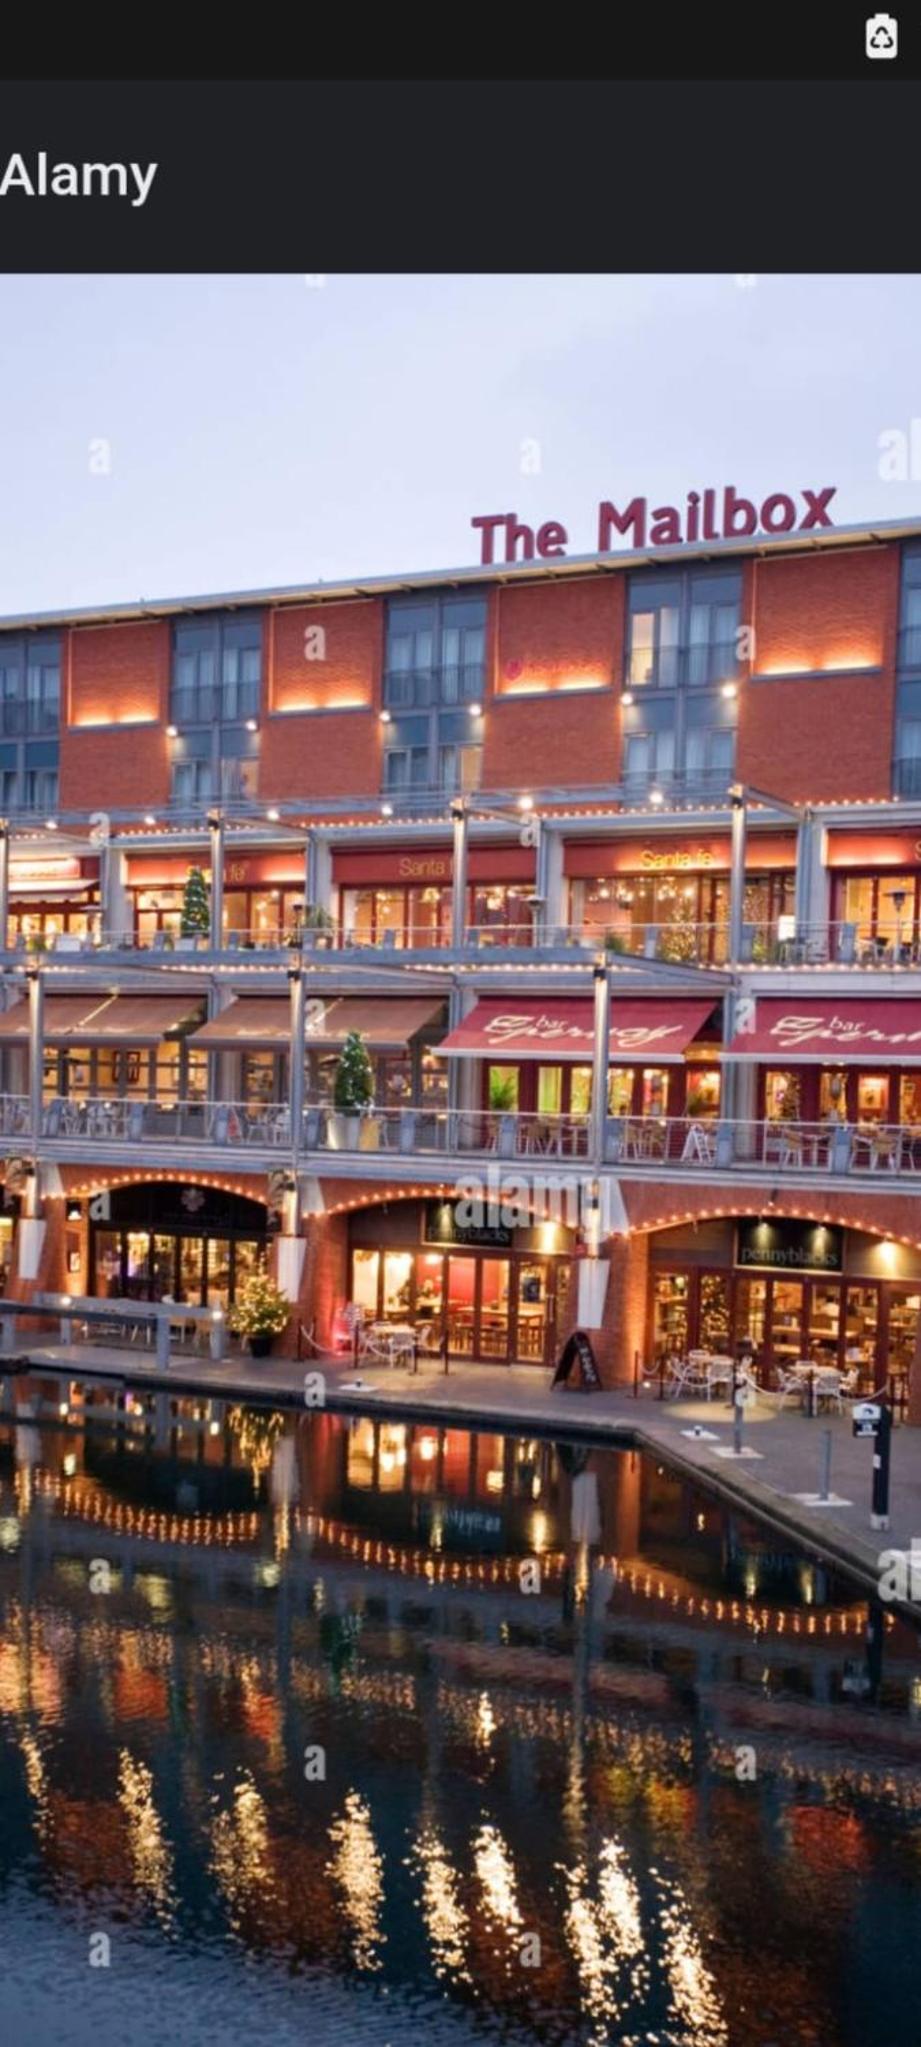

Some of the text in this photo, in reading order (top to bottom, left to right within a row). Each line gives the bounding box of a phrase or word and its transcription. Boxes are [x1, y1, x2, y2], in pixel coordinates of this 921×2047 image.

[0, 152, 158, 207] Alamy
[471, 485, 837, 565] The Mailbox
[399, 857, 446, 876] Santa
[640, 850, 691, 869] Santa
[537, 1015, 568, 1029] bar
[829, 1015, 864, 1031] bar
